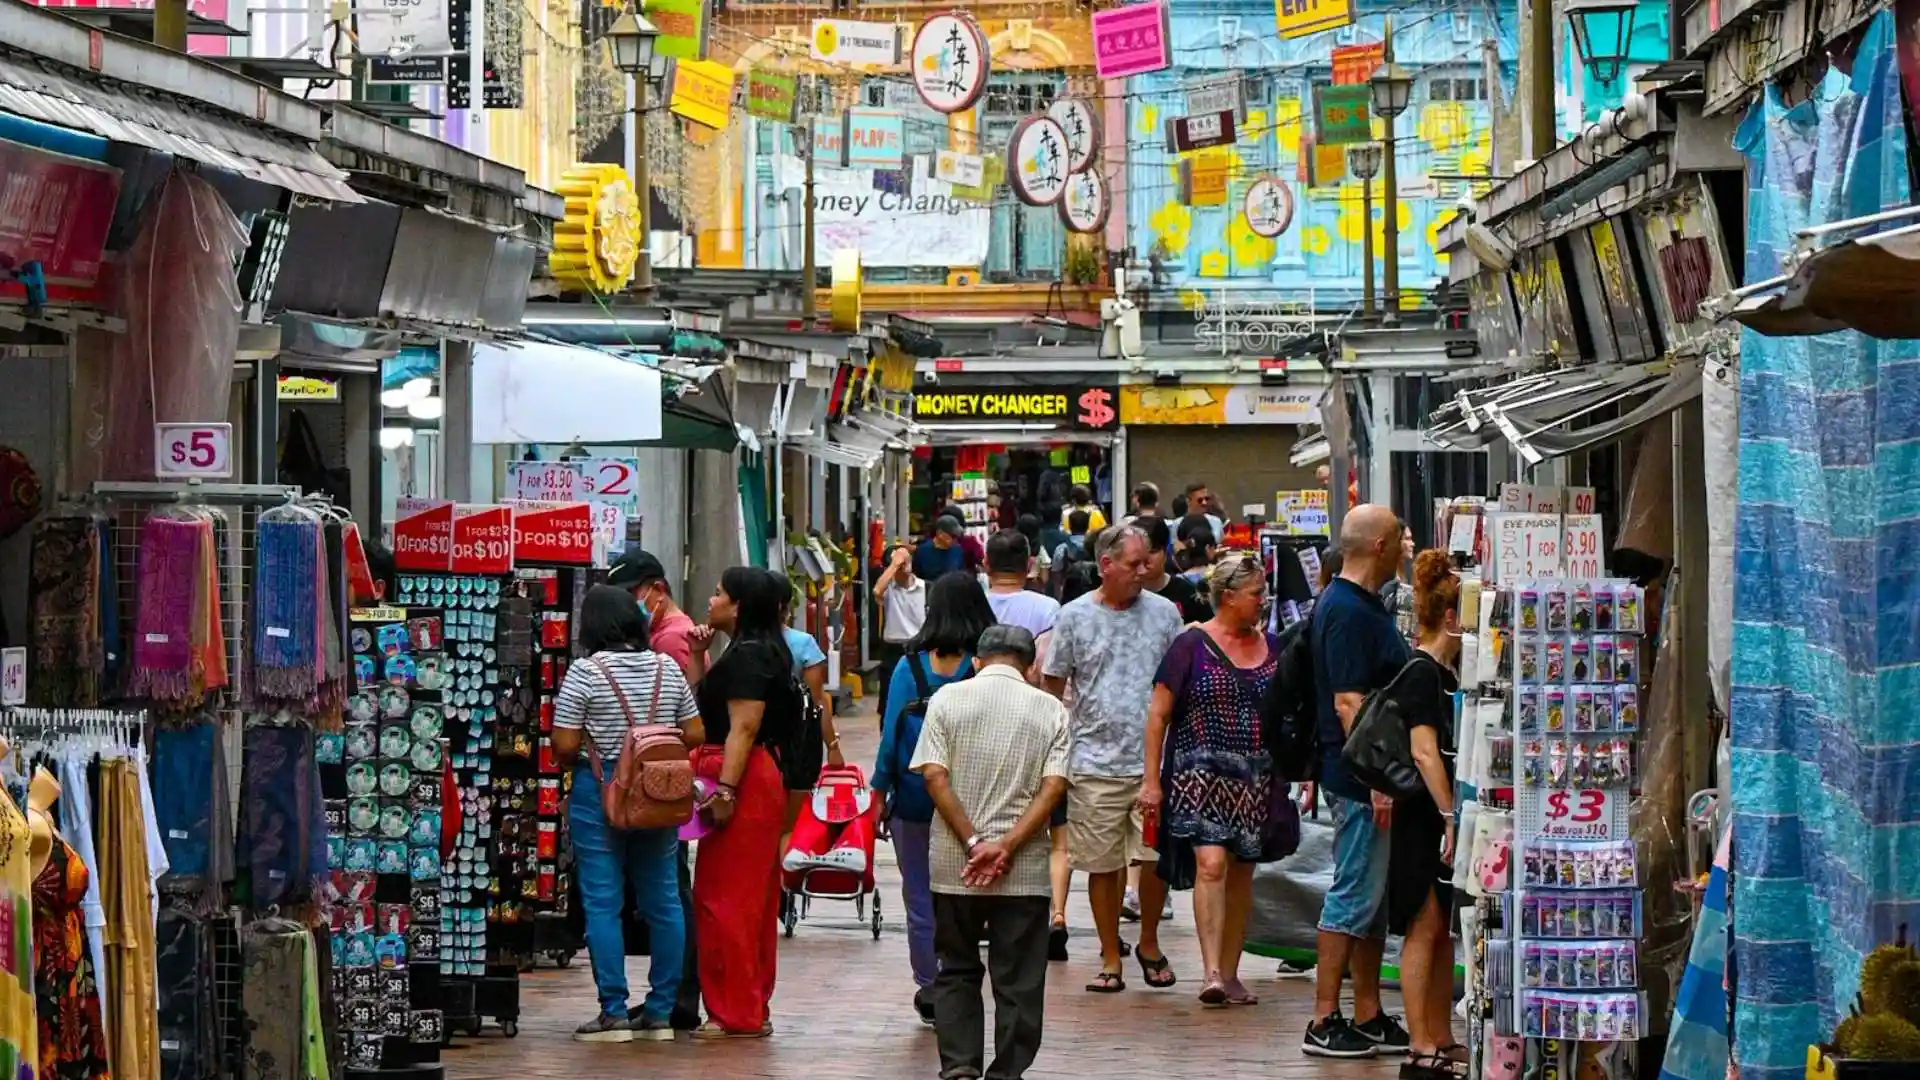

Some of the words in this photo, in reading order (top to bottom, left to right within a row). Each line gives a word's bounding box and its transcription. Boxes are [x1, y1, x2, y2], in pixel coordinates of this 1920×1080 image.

[945, 22, 970, 97] 牛车水
[1040, 124, 1062, 190] 牛车水
[916, 394, 980, 415] MONEY
[982, 394, 1067, 415] CHANGER
[171, 431, 216, 468] $5
[1525, 520, 1558, 528] MASK
[408, 538, 429, 553] FOR
[524, 532, 556, 546] FOR
[558, 530, 589, 548] $10
[1538, 541, 1556, 557] FOR
[419, 784, 433, 797] SG
[1545, 789, 1605, 822] $3
[419, 896, 434, 908] SG
[419, 934, 433, 946] SG
[356, 975, 370, 987] SG
[354, 1008, 369, 1021] SG
[387, 1012, 401, 1025] SG
[419, 1019, 433, 1031] SG
[361, 1044, 375, 1058] SG
